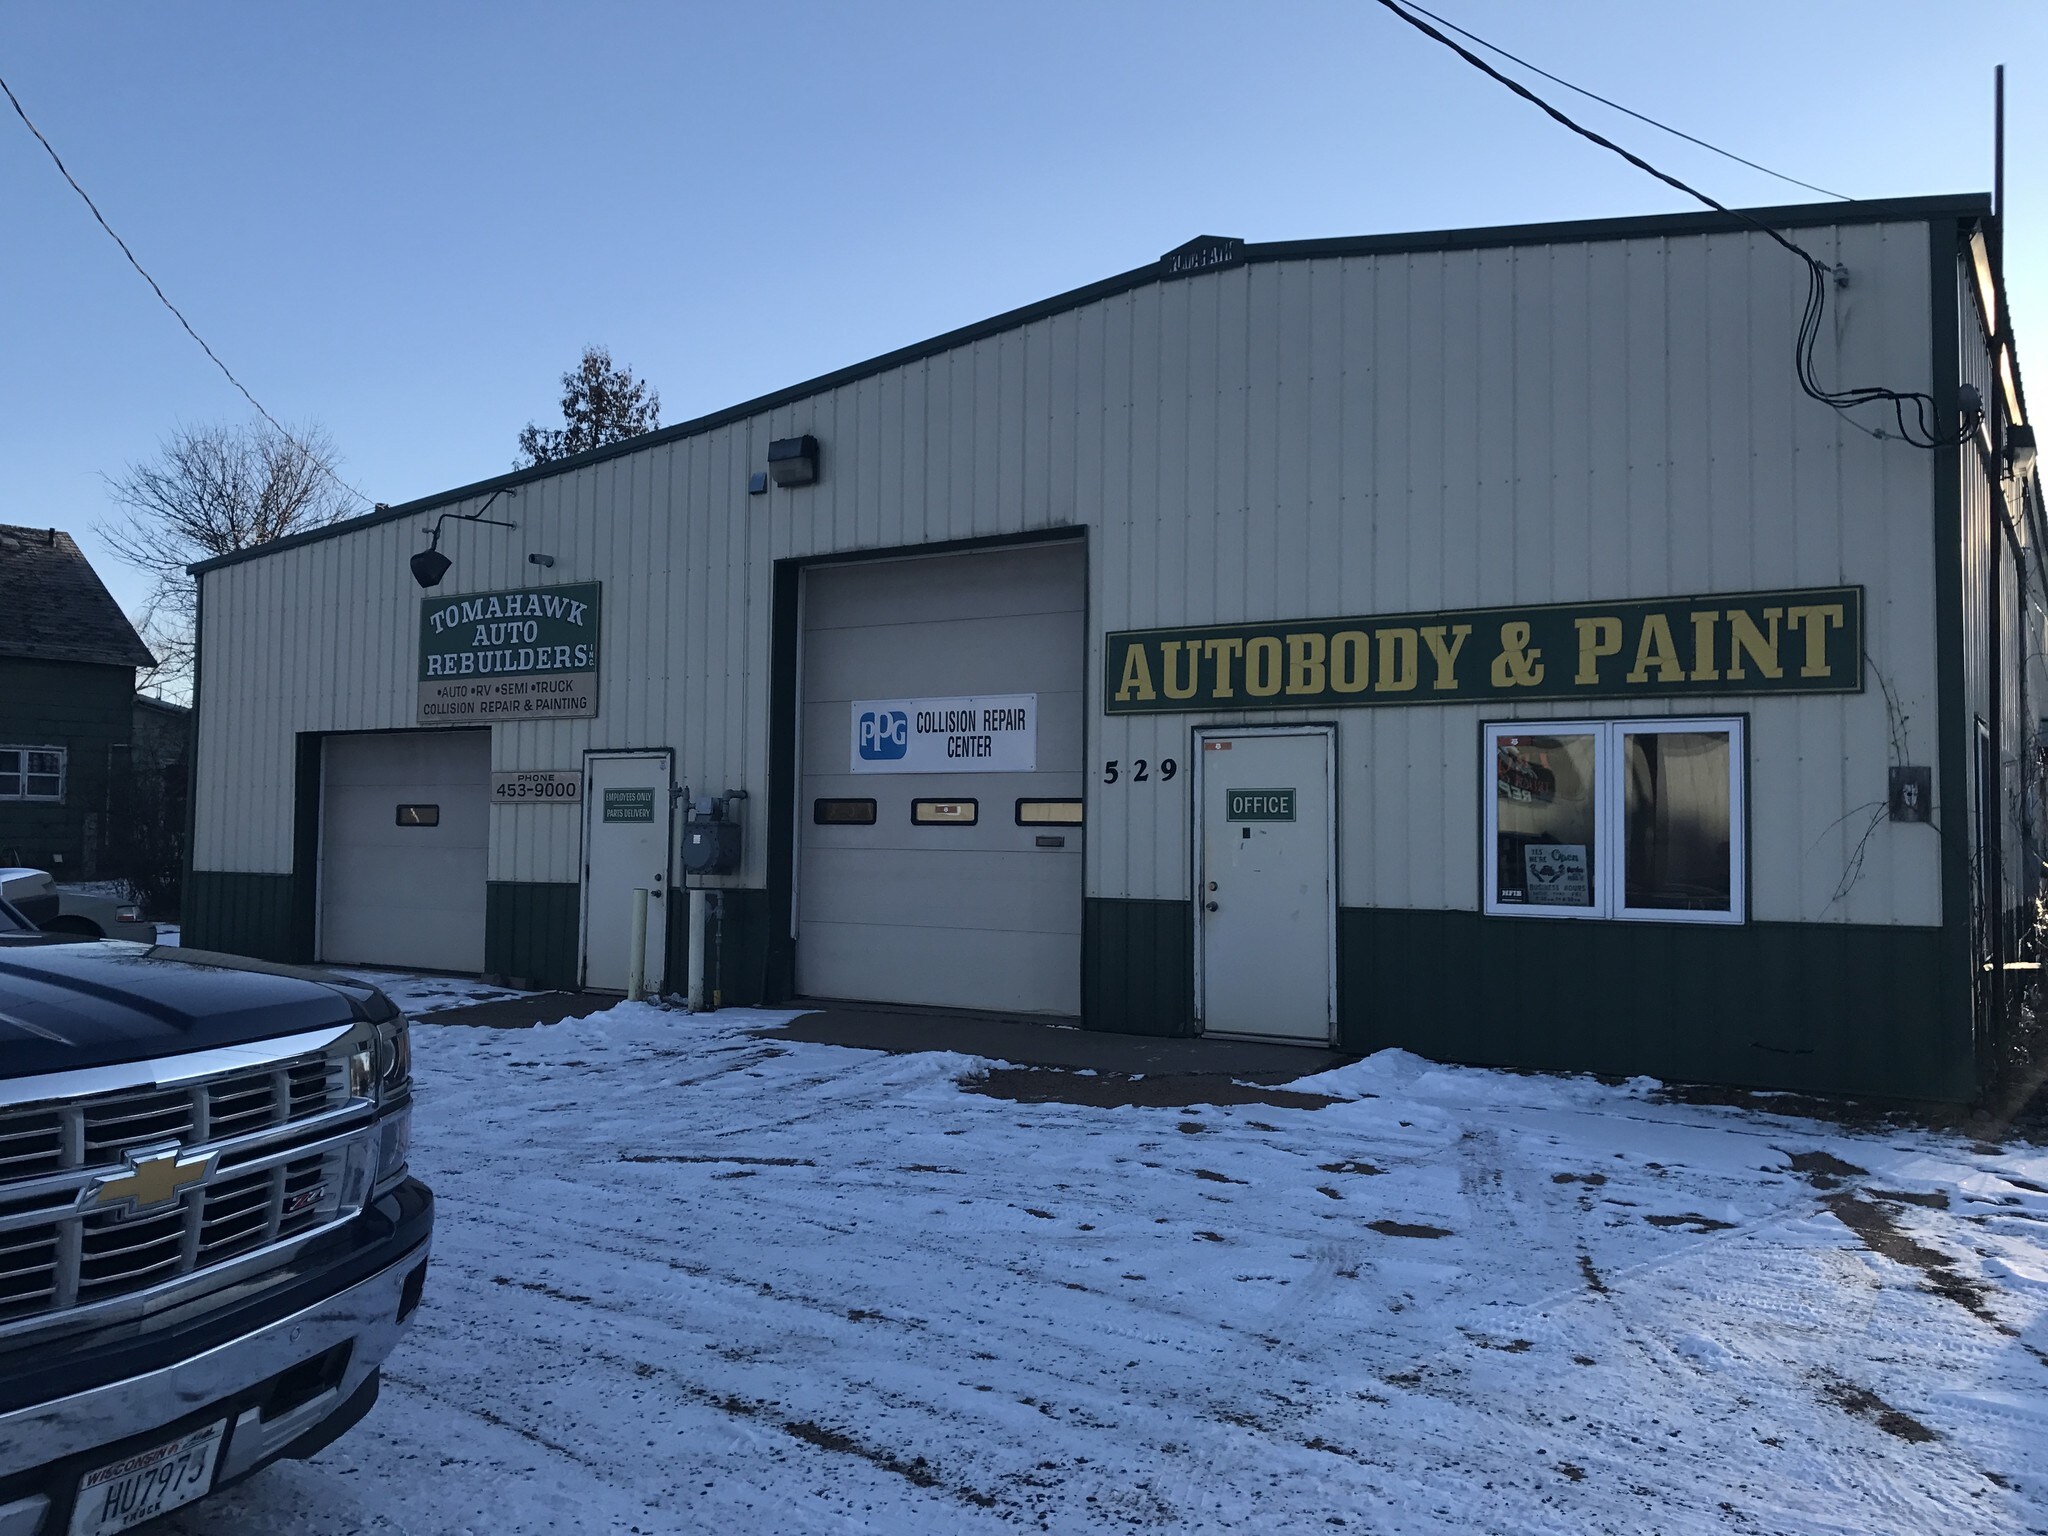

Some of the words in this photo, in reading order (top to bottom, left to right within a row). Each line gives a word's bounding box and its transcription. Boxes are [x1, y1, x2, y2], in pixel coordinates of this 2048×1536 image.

[430, 594, 588, 634] TOMAHAWK
[472, 620, 538, 646] AUTO
[427, 644, 587, 676] REBUILDERS
[1115, 624, 1473, 702] AUTOBODY
[1491, 621, 1545, 687] &
[1574, 604, 1844, 685] PAINT
[423, 702, 475, 715] COLLISION
[480, 699, 520, 713] REPAIR
[524, 700, 533, 711] &
[536, 697, 587, 710] PAINTING
[861, 711, 907, 752] PPG
[916, 709, 976, 734] COLLISION
[983, 708, 1026, 732] REPAIR
[947, 735, 992, 758] CENTER
[518, 774, 555, 782] PHONE
[1103, 758, 1178, 784] 529
[496, 782, 576, 798] 453-9000
[605, 792, 636, 802] EMPLOYEES
[636, 792, 652, 802] ONLY
[606, 808, 624, 818] PARTS
[624, 808, 651, 818] DELIVERY
[1232, 796, 1289, 814] OFFICE
[1551, 849, 1579, 862] Open
[87, 1449, 167, 1487] WISCONSIN
[122, 1501, 162, 1525] TRUCK
